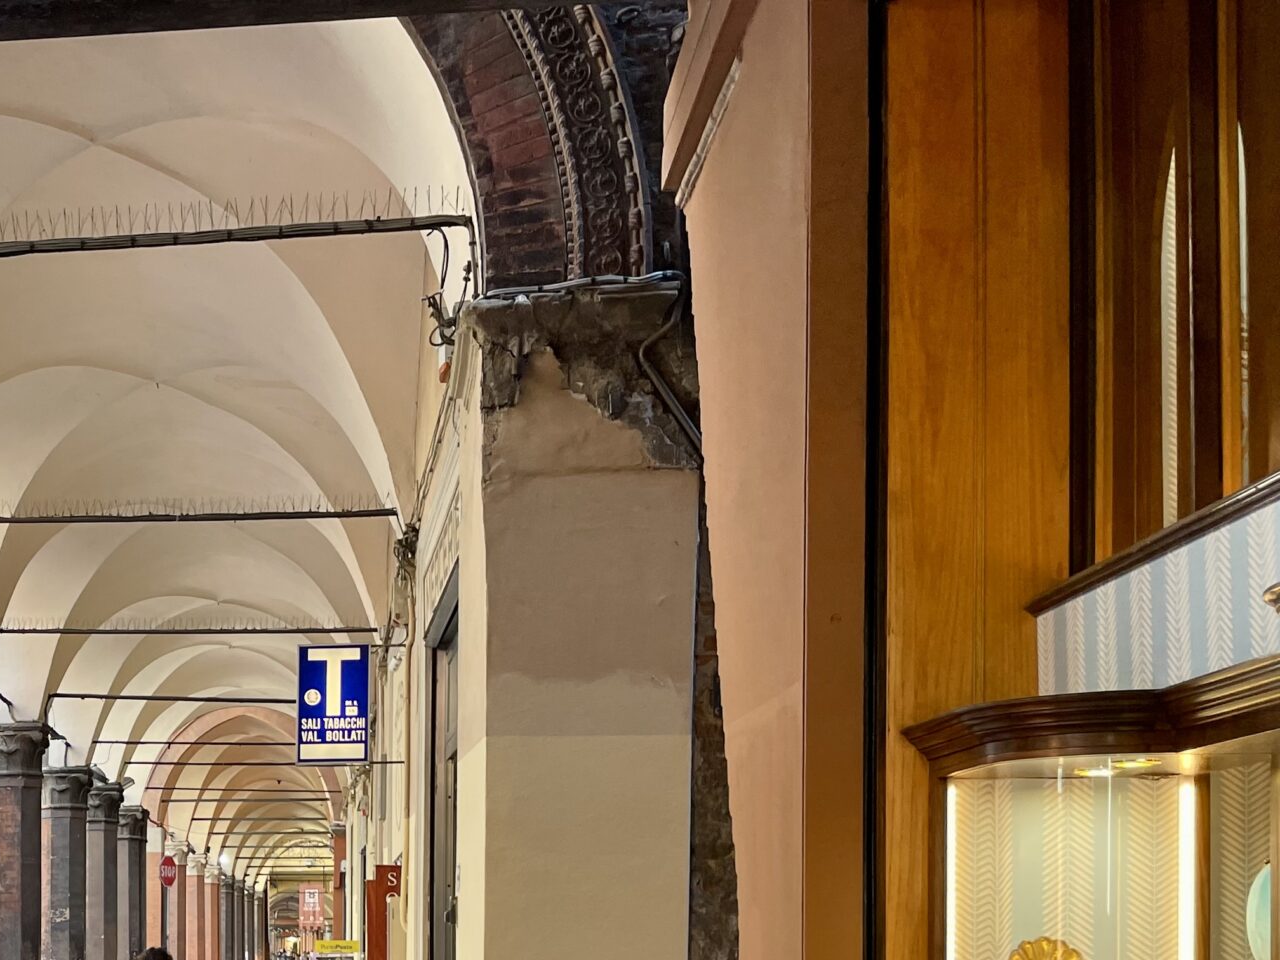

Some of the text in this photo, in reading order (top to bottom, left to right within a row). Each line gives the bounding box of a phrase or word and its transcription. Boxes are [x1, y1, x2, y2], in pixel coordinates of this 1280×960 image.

[308, 648, 360, 716] T
[301, 717, 365, 730] SALI TABACCHI
[302, 730, 365, 742] VAL. BOLLATI
[161, 865, 175, 877] STOP
